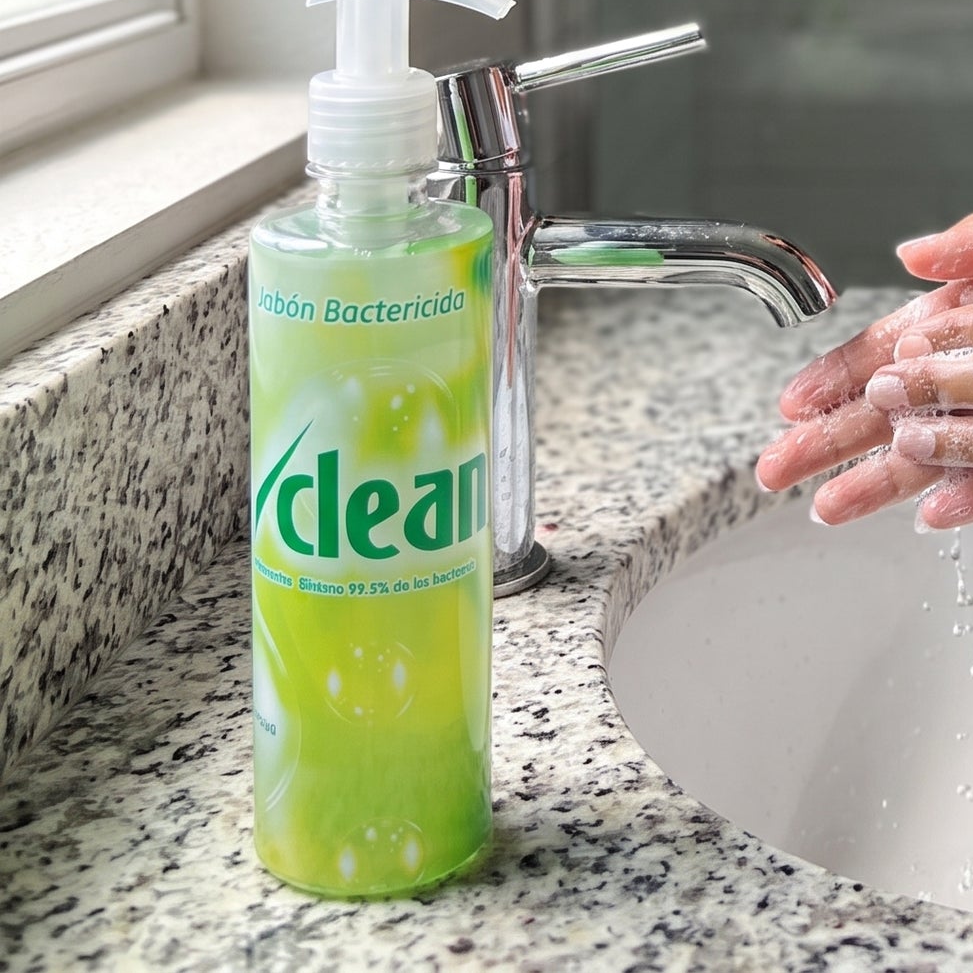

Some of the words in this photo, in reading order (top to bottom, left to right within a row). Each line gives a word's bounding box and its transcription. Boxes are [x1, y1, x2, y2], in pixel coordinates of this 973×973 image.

[258, 286, 315, 321] Jabón
[323, 288, 465, 323] Bactericida
[348, 582, 389, 595] 99.5%
[413, 576, 429, 589] los
